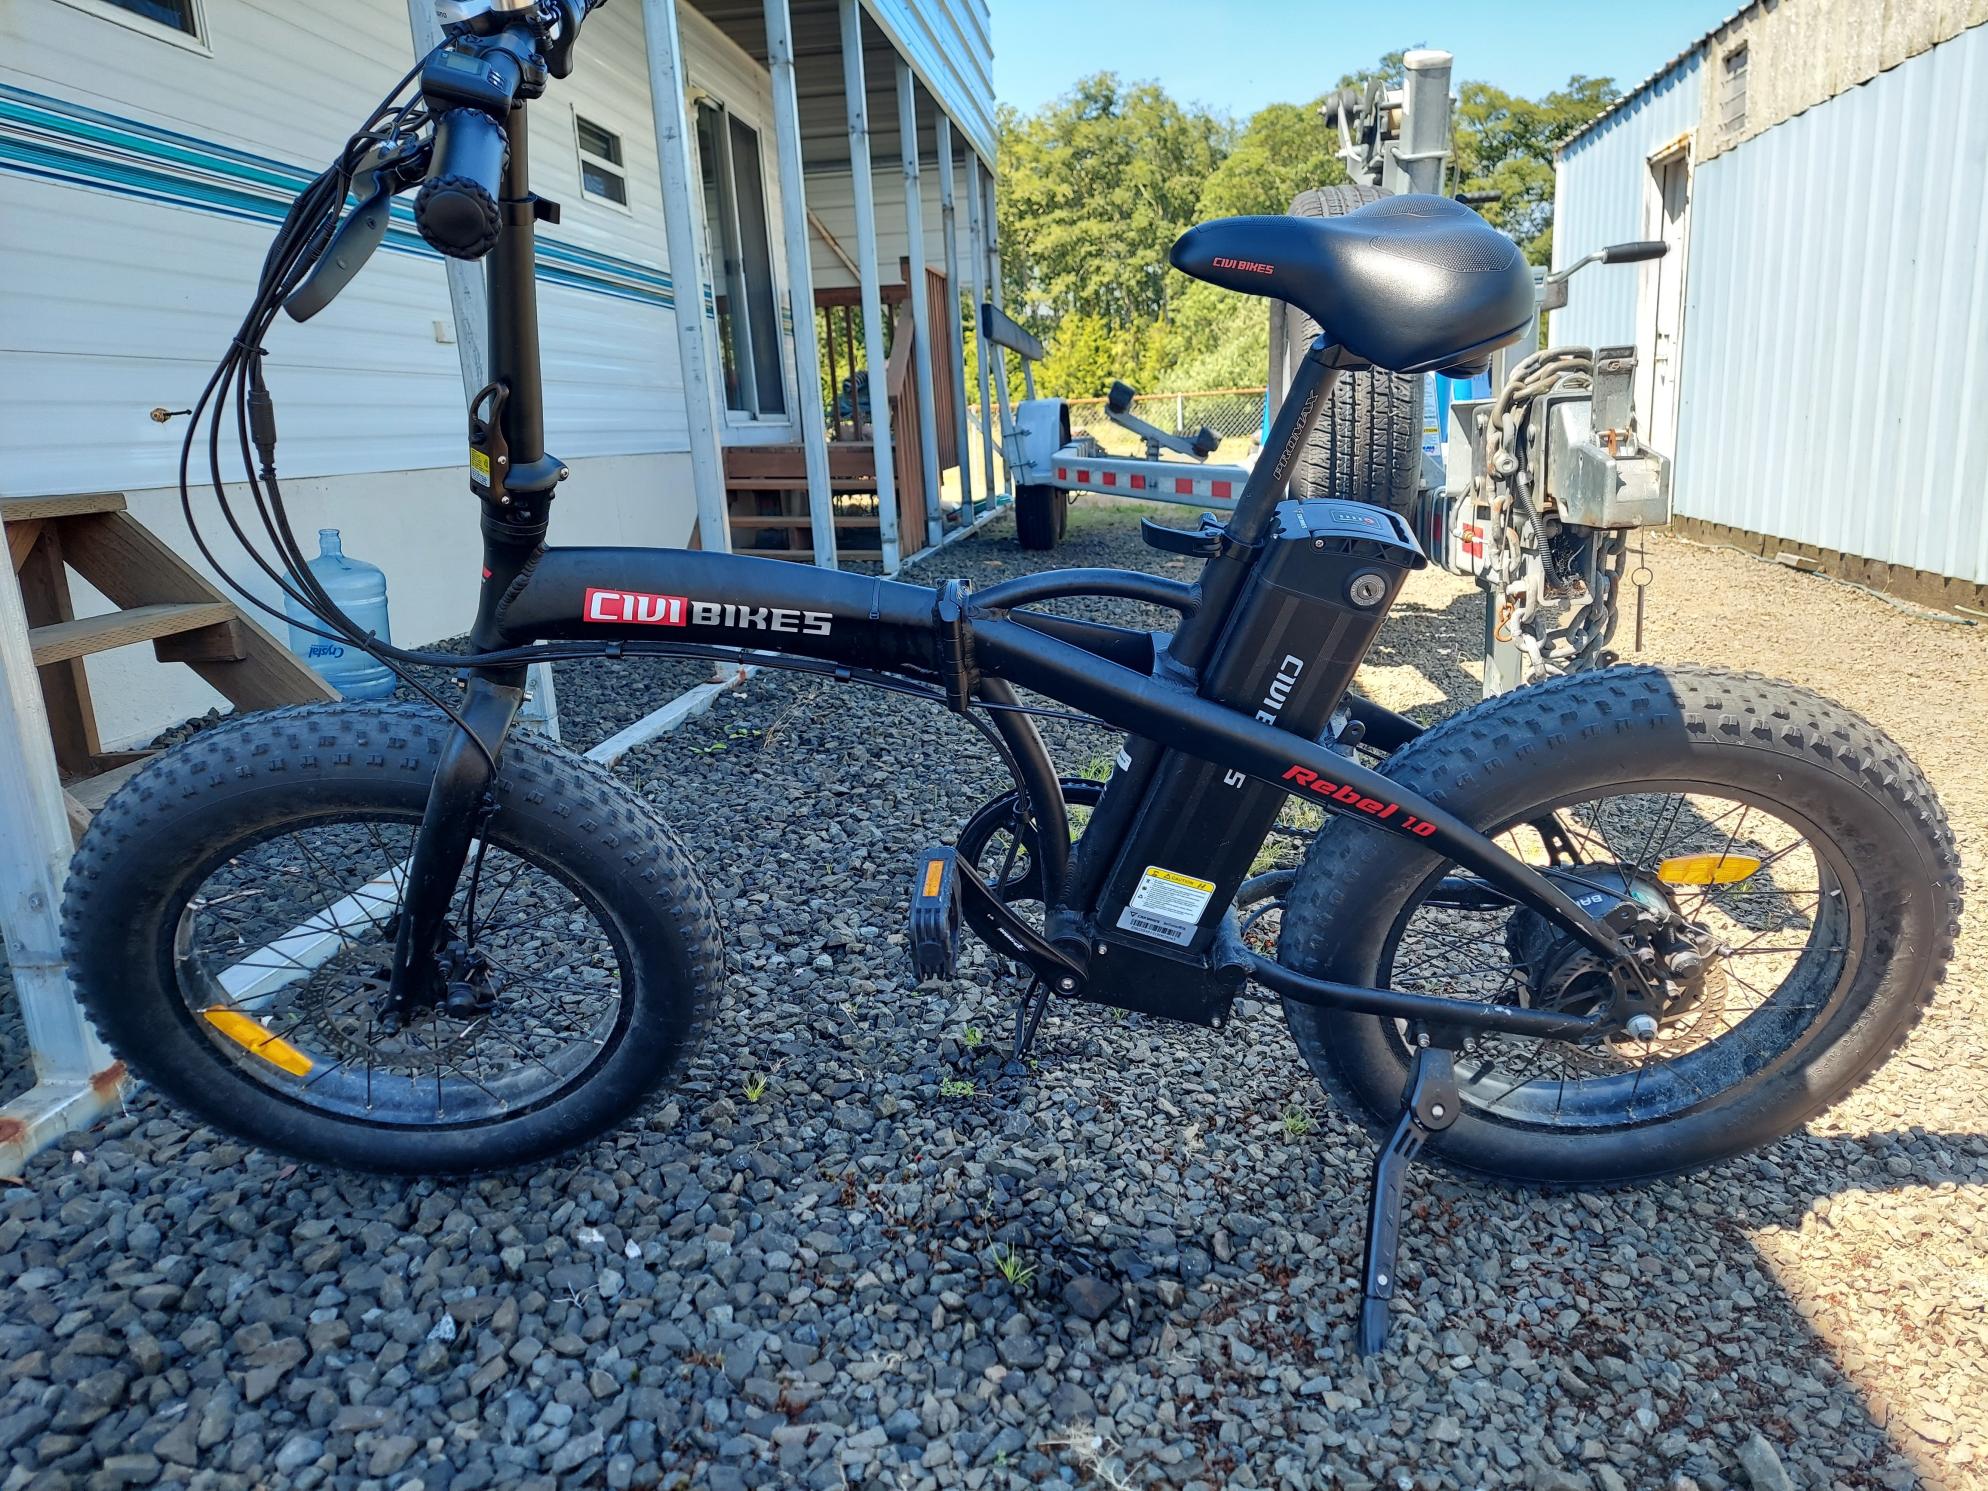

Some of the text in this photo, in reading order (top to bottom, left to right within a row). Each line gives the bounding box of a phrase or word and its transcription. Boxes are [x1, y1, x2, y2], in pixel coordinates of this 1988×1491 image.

[1237, 260, 1275, 275] BIKES
[1273, 389, 1319, 481] PROMAX
[590, 592, 833, 636] CIVI BIKES
[308, 645, 345, 659] Crystal
[1281, 764, 1438, 837] Rebel 1.0
